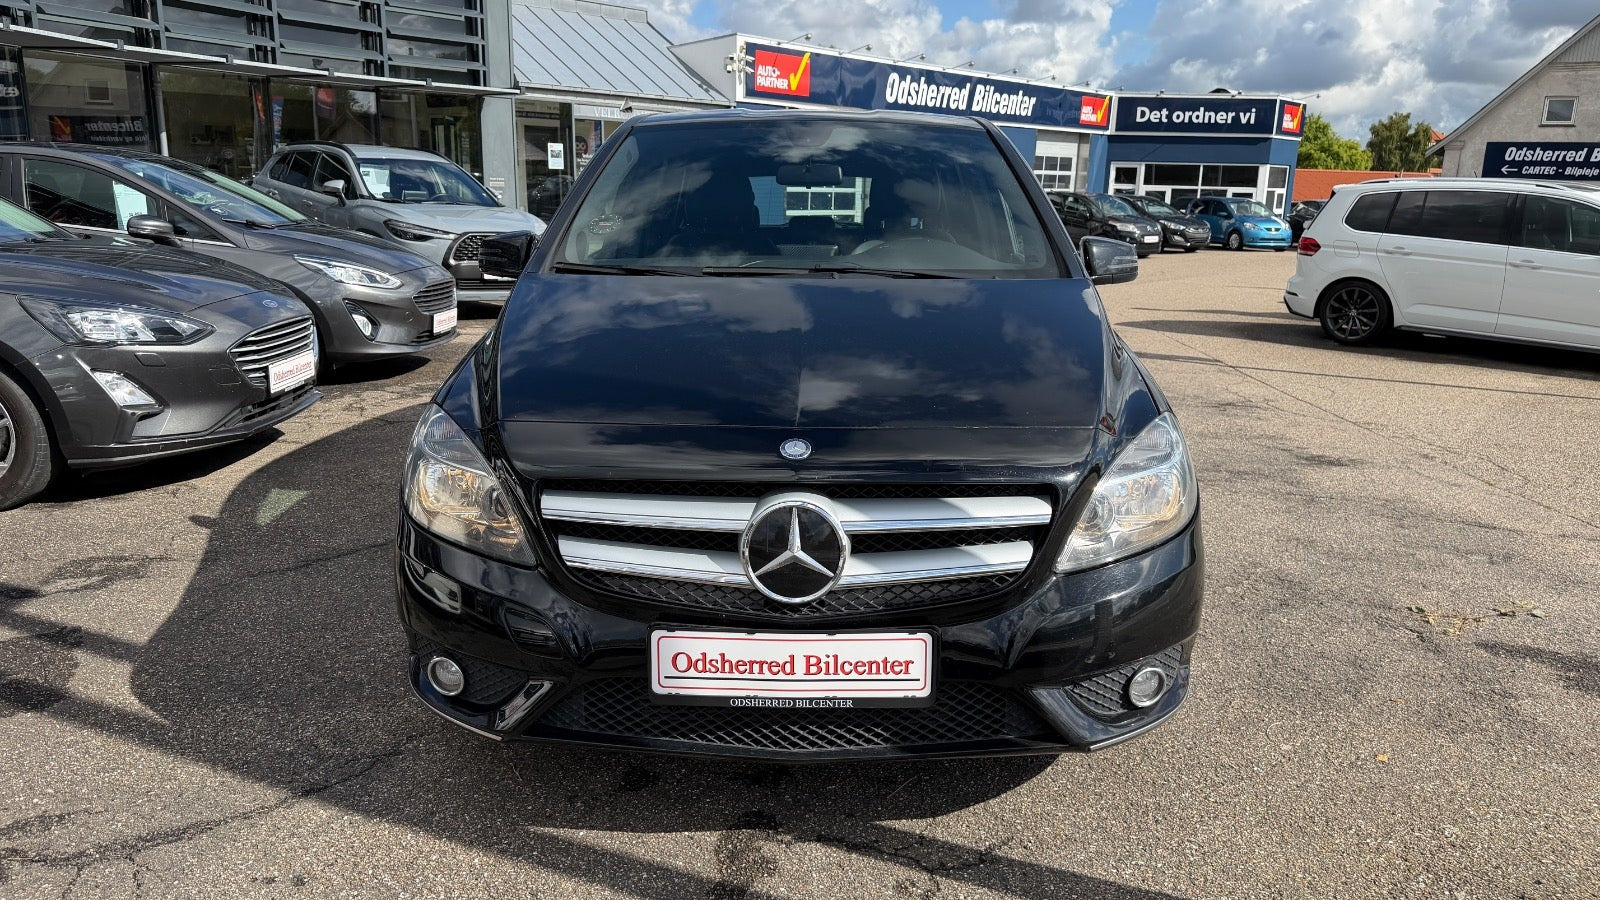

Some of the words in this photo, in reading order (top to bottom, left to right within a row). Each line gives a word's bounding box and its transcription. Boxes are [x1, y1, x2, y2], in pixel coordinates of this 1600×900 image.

[757, 65, 781, 77] AUTO-
[756, 75, 789, 90] PARTNER
[885, 72, 971, 111] Odsherred
[972, 84, 1037, 116] Bilcenter
[1135, 106, 1169, 123] Det
[1172, 106, 1236, 124] ordner
[1240, 108, 1256, 125] vi
[1504, 146, 1589, 162] Odsherred
[1521, 165, 1557, 175] CARTEC
[1564, 166, 1600, 178] Bilpleje
[671, 651, 797, 676] Odsherred
[803, 654, 914, 676] Bilcenter
[729, 698, 794, 708] ODSHERRED
[795, 698, 854, 709] BILCENTER
